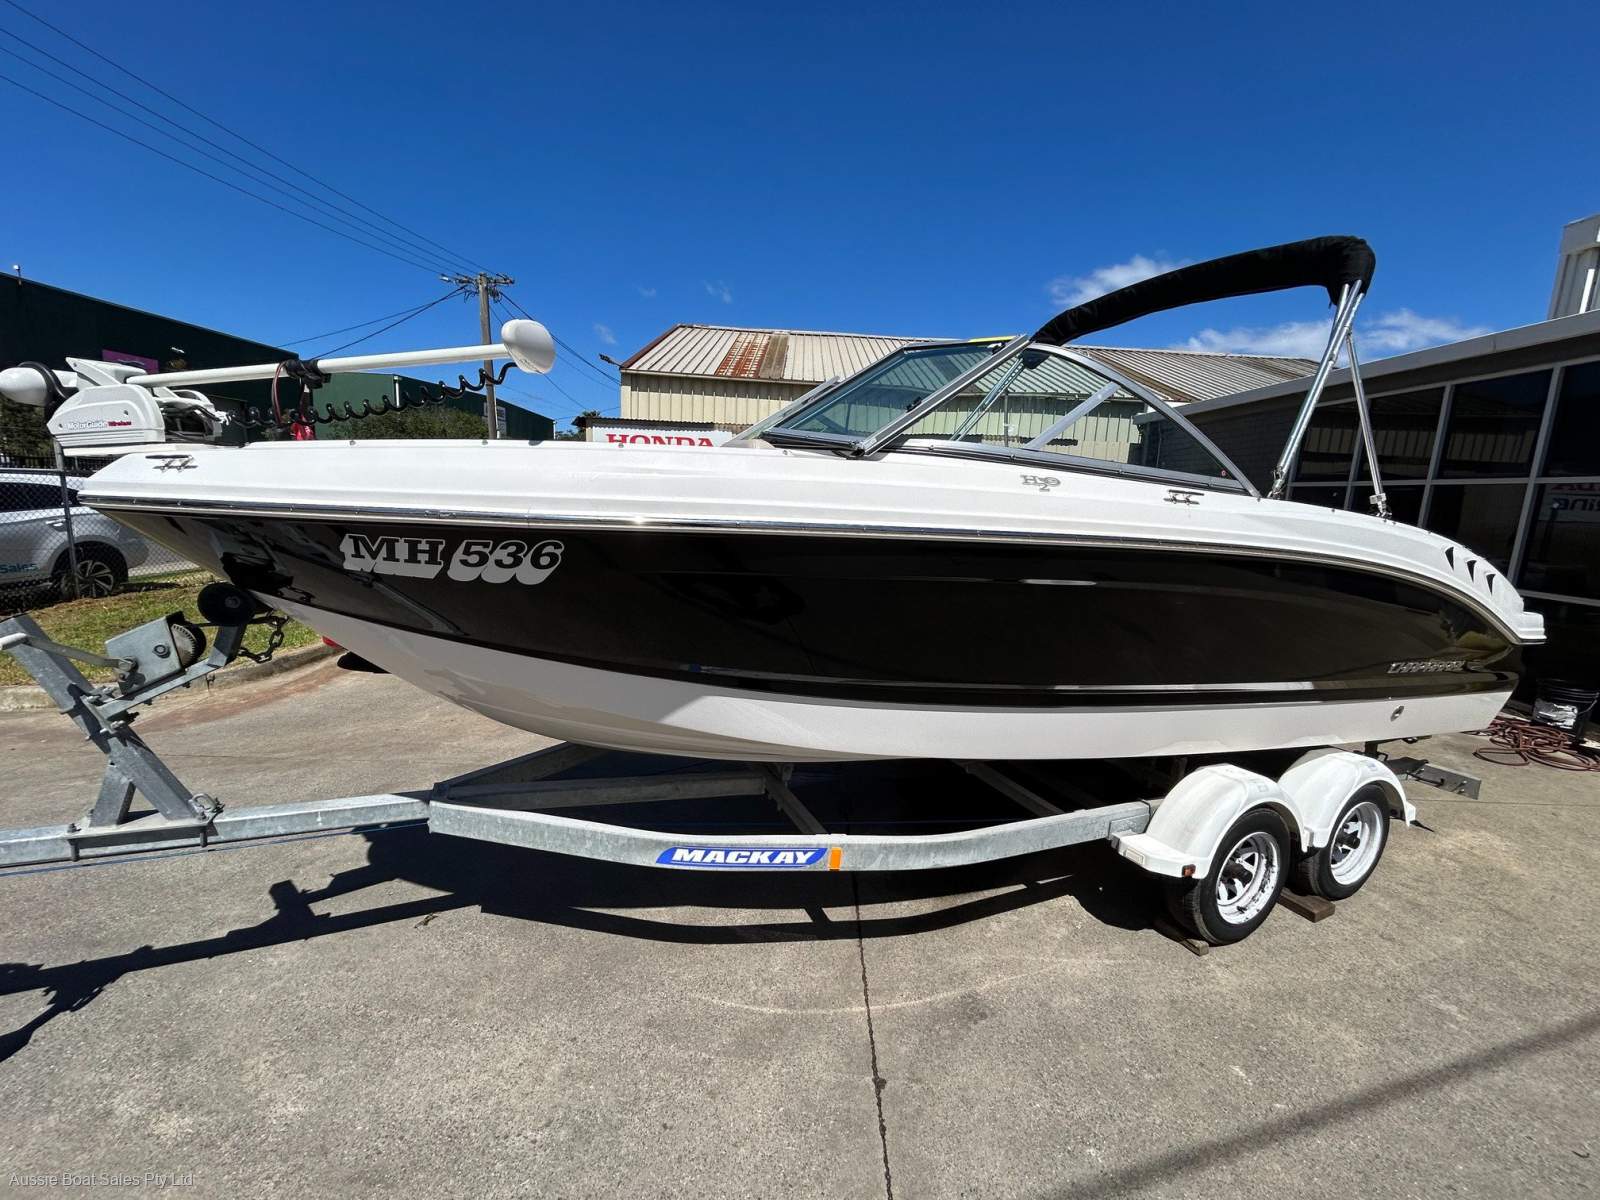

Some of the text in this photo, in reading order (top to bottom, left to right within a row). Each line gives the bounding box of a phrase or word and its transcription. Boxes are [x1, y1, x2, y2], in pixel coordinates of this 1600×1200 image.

[343, 533, 564, 579] MH 536
[672, 848, 815, 865] MACKAY
